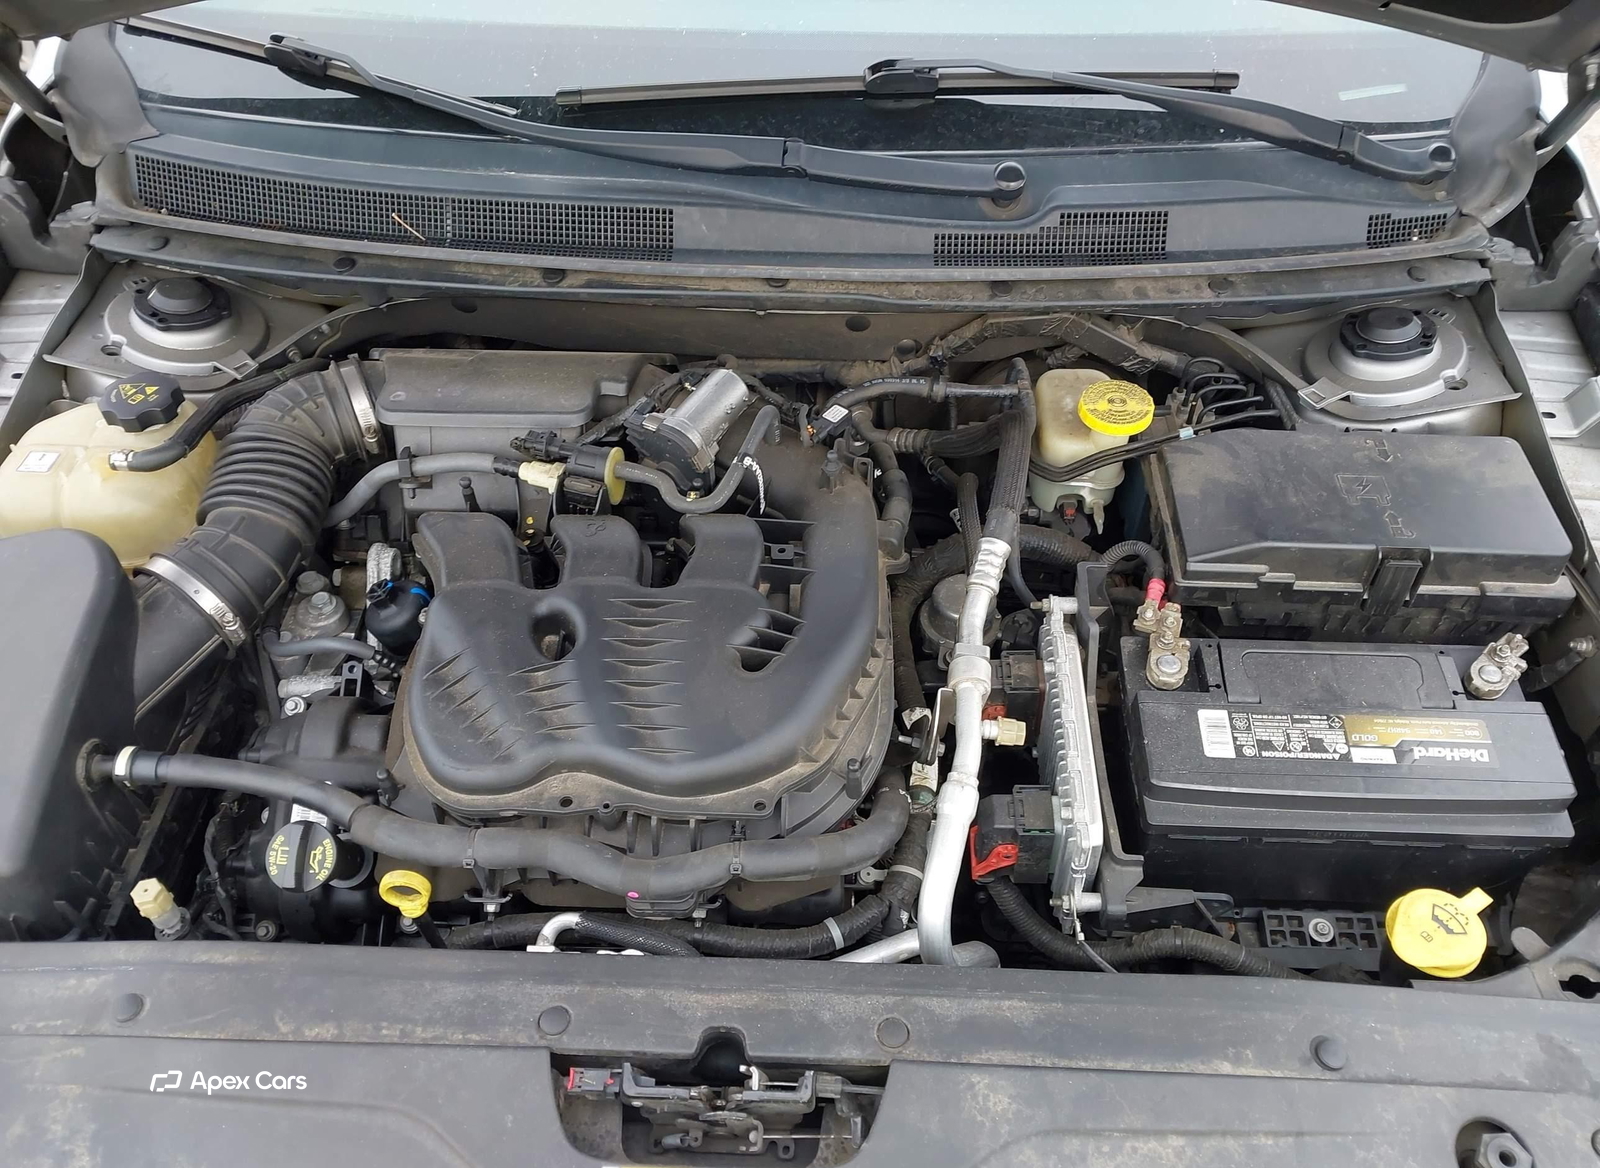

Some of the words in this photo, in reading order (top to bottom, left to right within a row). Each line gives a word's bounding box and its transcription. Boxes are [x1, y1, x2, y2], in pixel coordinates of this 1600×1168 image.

[1351, 734, 1378, 742] GOLD
[1261, 751, 1333, 760] DANGER/POISON
[1411, 746, 1490, 763] DieHard
[272, 835, 285, 850] SAE
[322, 838, 334, 869] ENGINE
[315, 869, 329, 881] OIL
